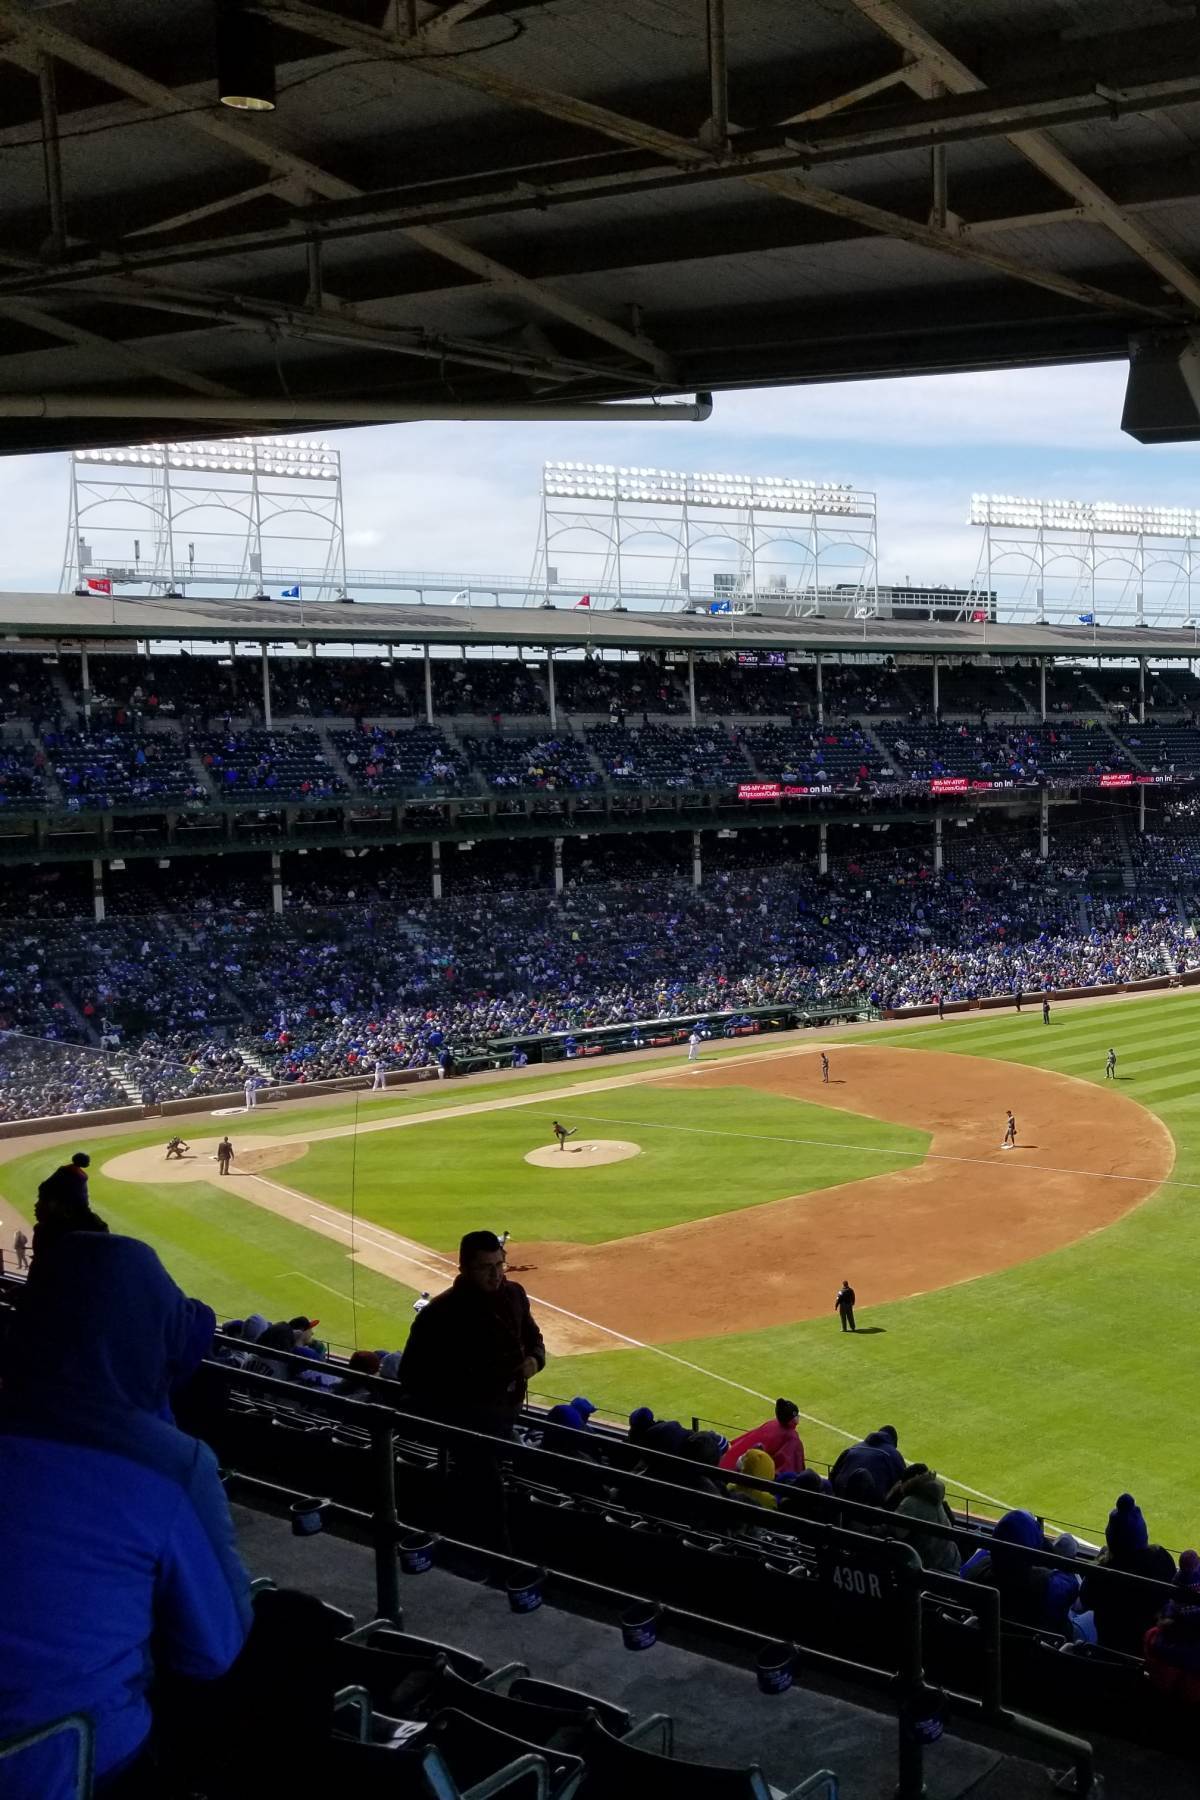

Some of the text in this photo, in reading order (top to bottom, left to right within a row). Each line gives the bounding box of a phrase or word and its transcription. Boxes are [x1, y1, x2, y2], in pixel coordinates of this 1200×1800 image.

[1136, 775, 1154, 783] Come
[972, 780, 993, 788] Come
[1004, 780, 1013, 788] In!
[784, 786, 808, 794] Come
[821, 785, 832, 793] In!
[833, 1565, 882, 1599] 430 R
